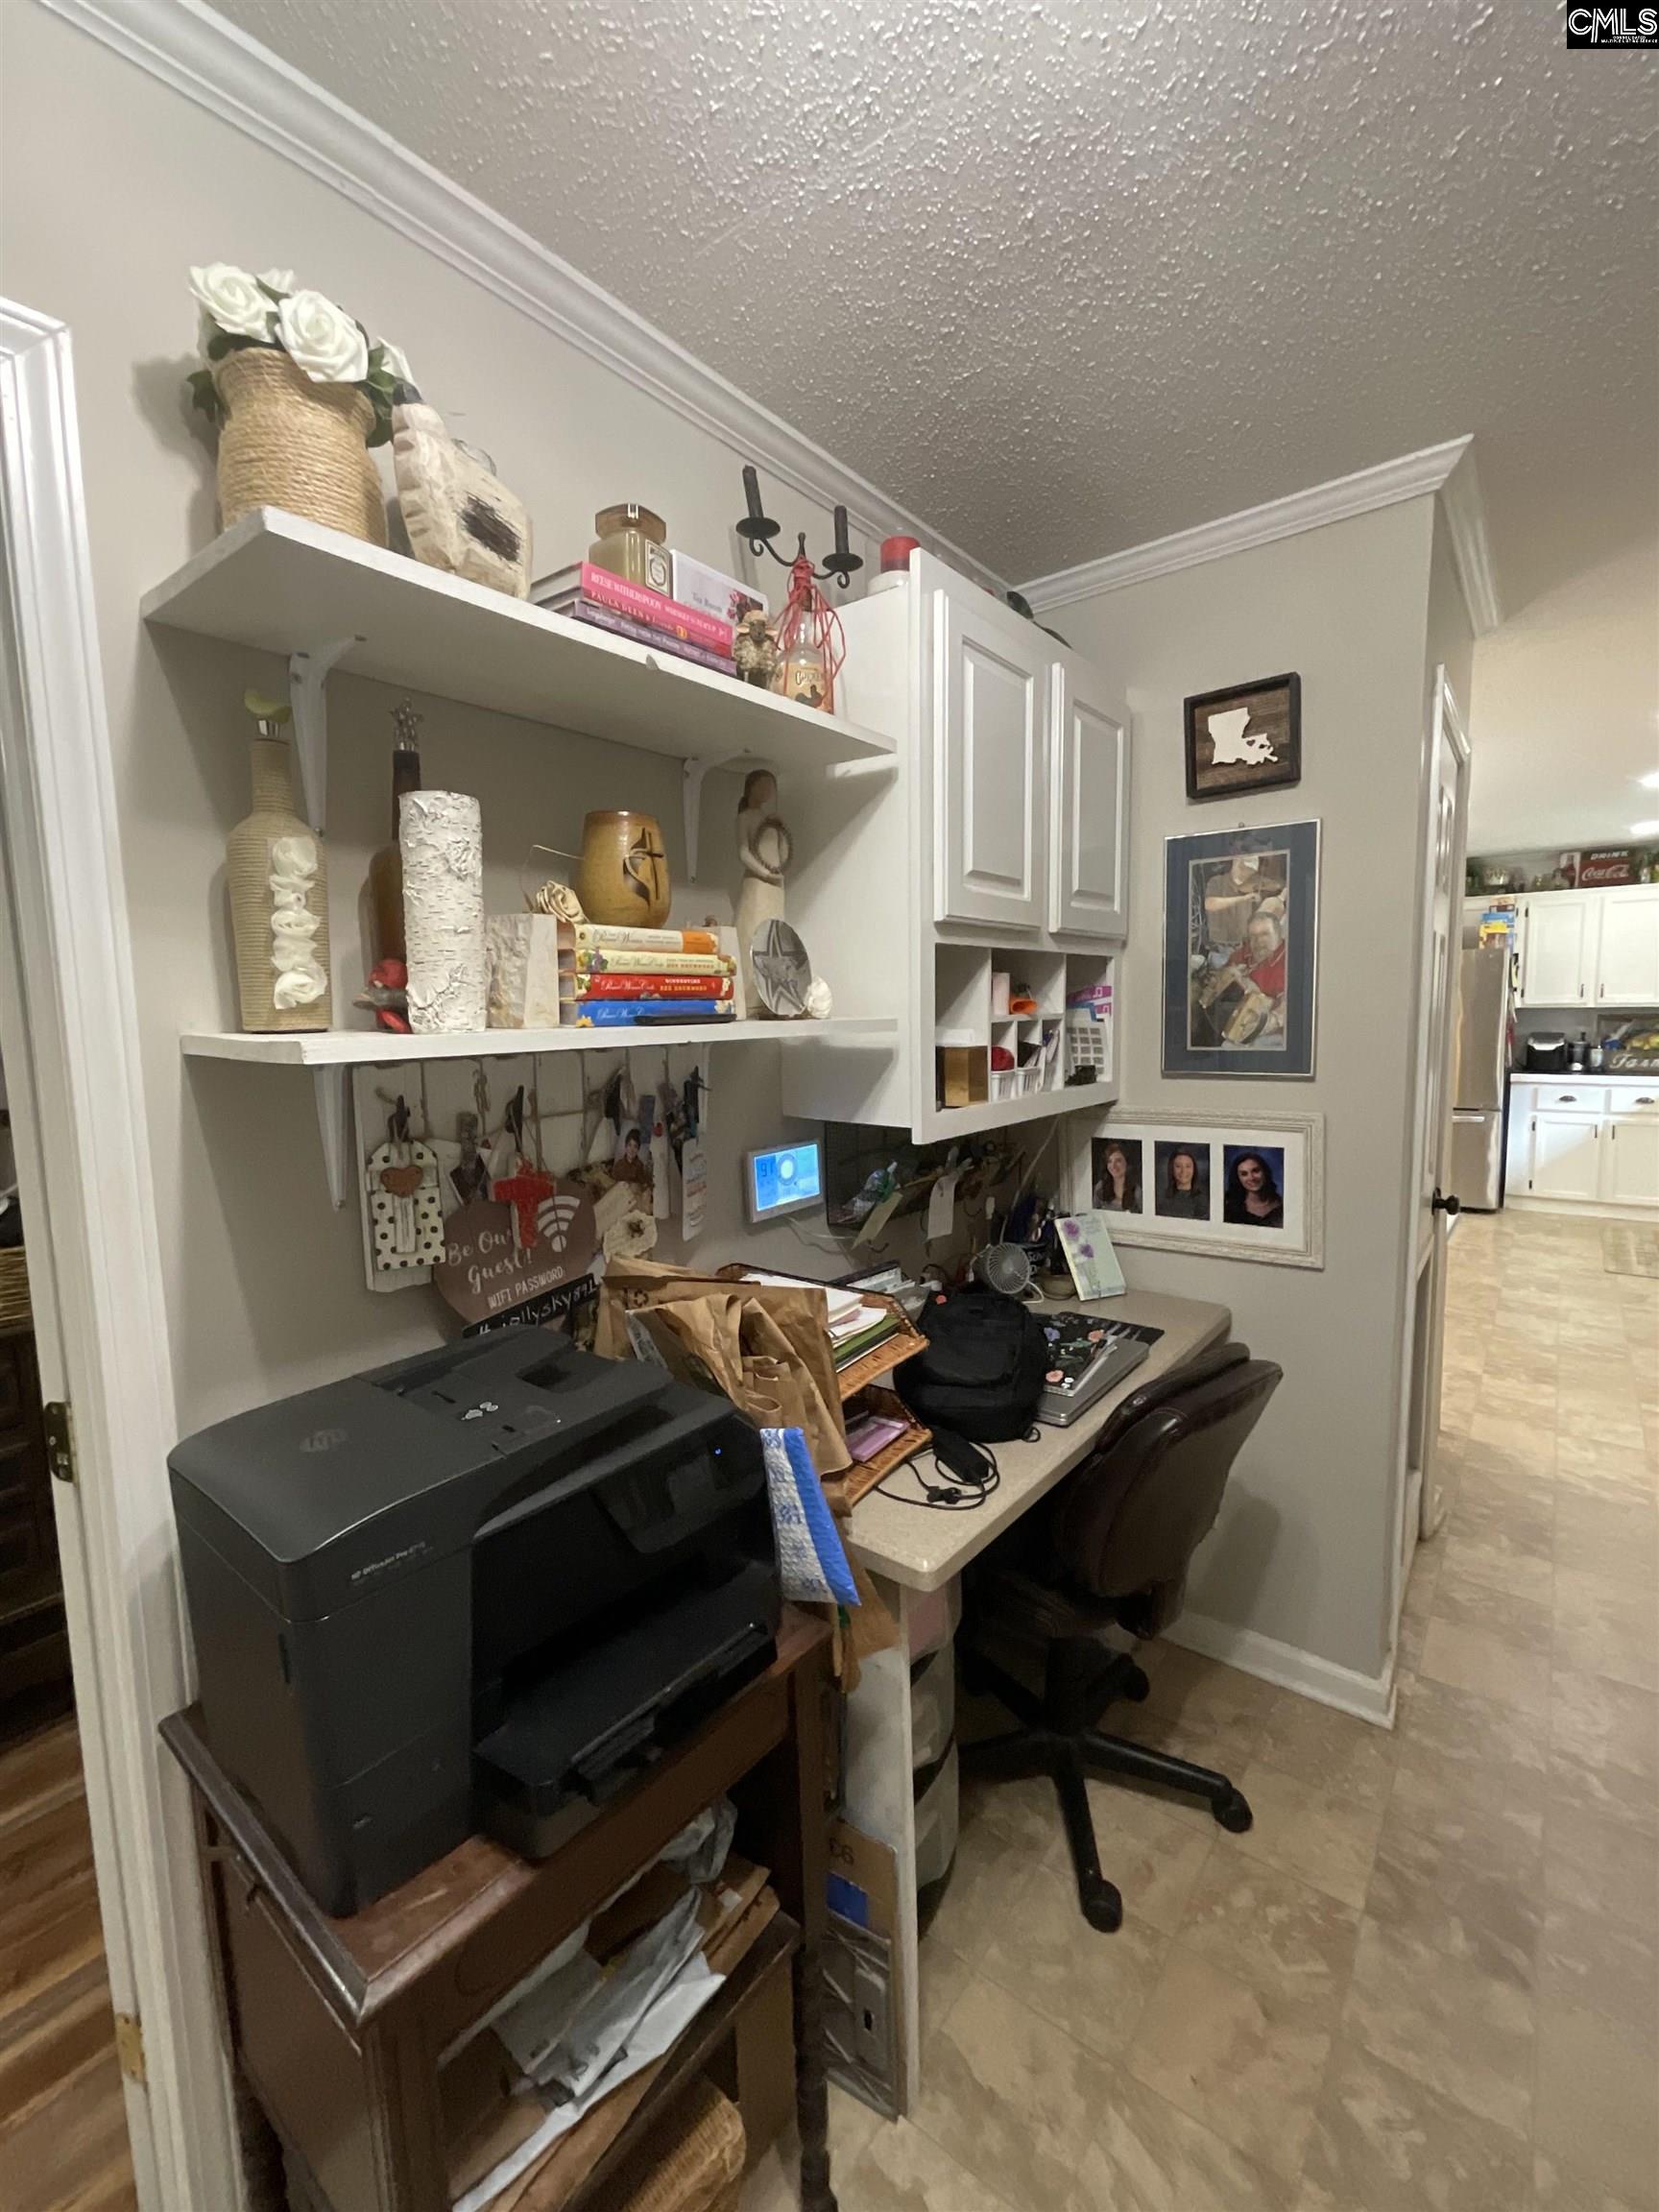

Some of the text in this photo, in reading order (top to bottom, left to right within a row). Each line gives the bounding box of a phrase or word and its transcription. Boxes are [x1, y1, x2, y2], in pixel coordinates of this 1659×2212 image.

[447, 1242, 473, 1266] Be
[487, 1266, 565, 1310] WIFI PASSWORD
